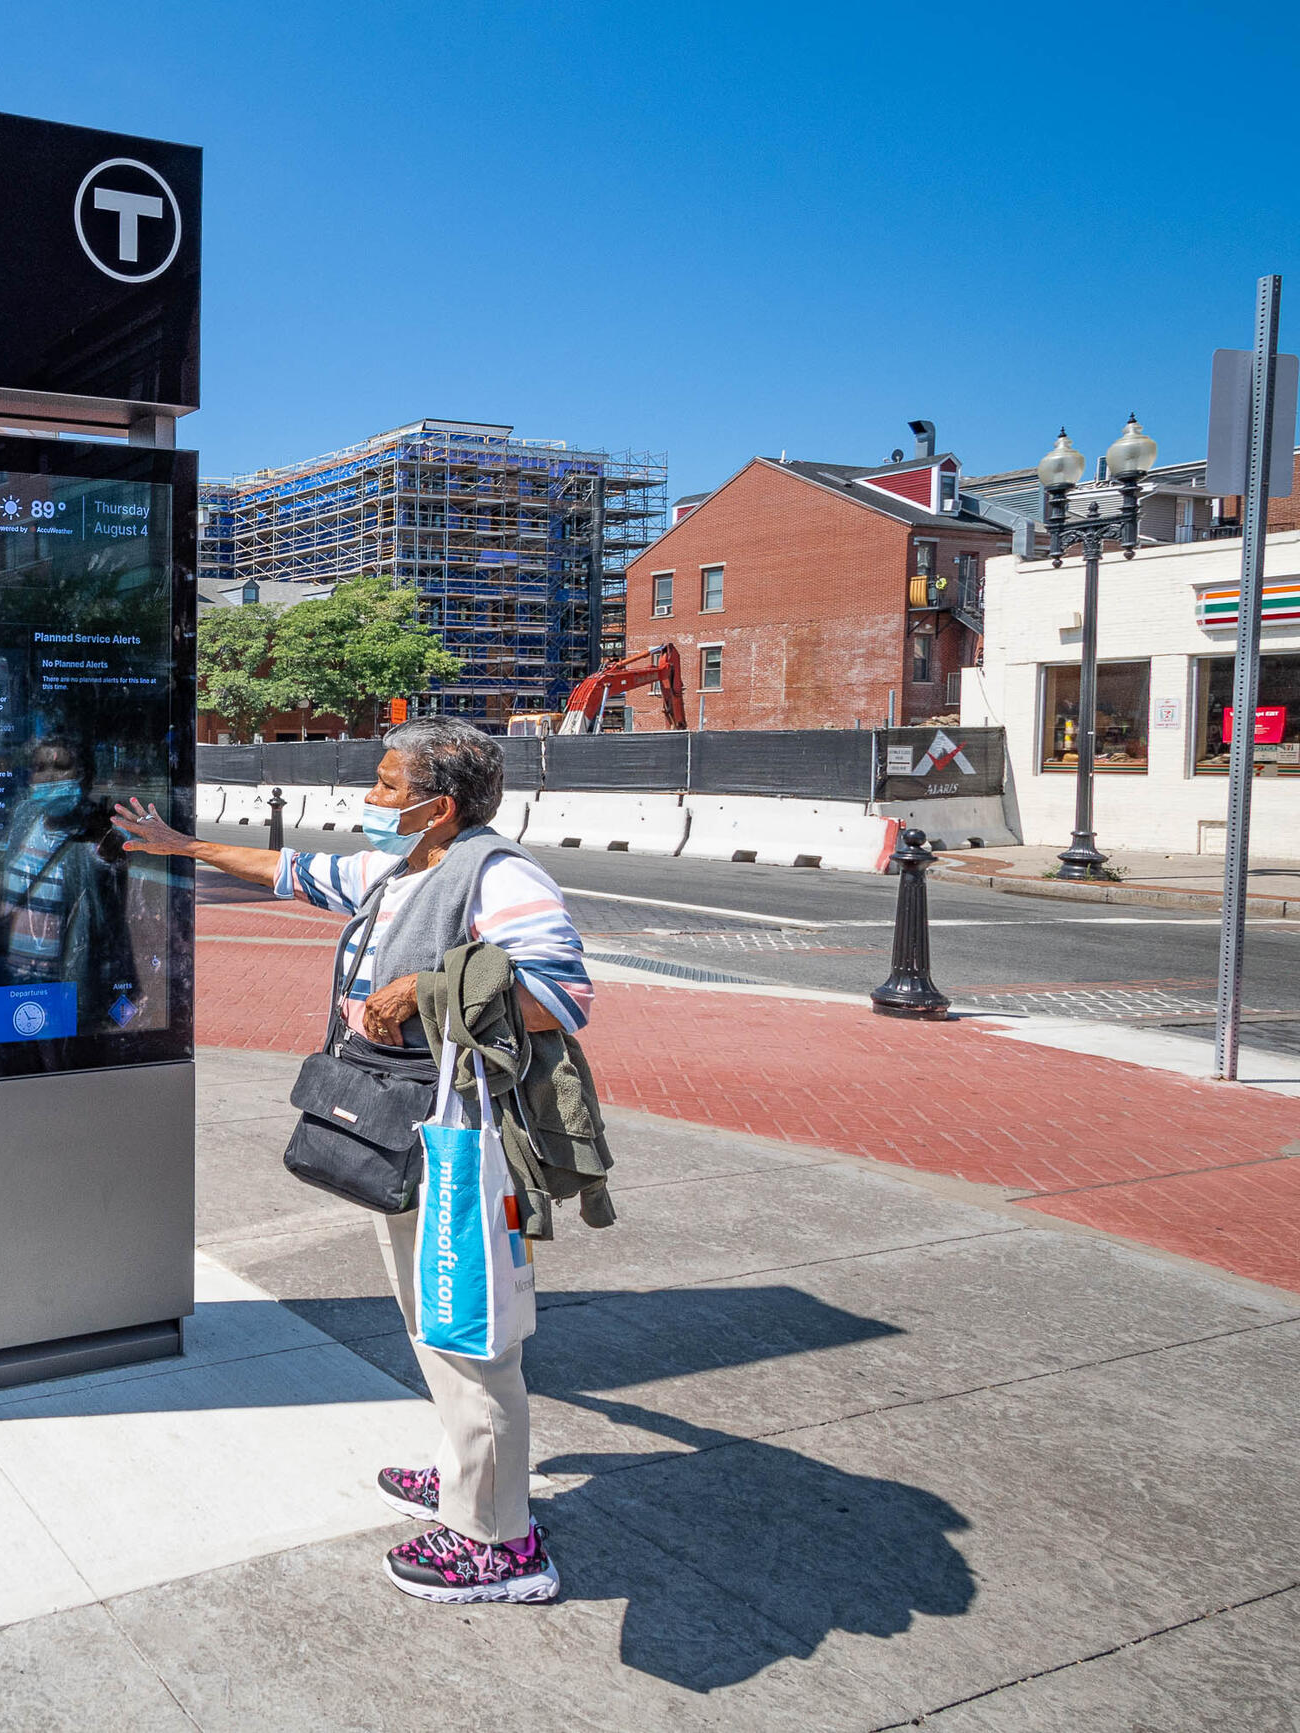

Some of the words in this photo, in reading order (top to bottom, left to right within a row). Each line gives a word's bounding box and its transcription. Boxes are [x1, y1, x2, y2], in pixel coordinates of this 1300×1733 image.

[94, 187, 163, 262] T
[94, 500, 150, 519] Thursday
[20, 525, 29, 534] by
[37, 527, 73, 535] AccuWeather
[94, 521, 137, 537] August
[140, 524, 148, 537] 4
[34, 632, 73, 643] Planned
[75, 633, 110, 644] Service
[112, 634, 141, 645] Alerts
[42, 660, 53, 668] No
[55, 660, 84, 669] Planned
[85, 661, 108, 669] Alerts
[925, 783, 959, 795] ALARIS
[112, 982, 132, 991] Alerts
[9, 988, 48, 999] Departures
[438, 1161, 458, 1324] microsoft.com
